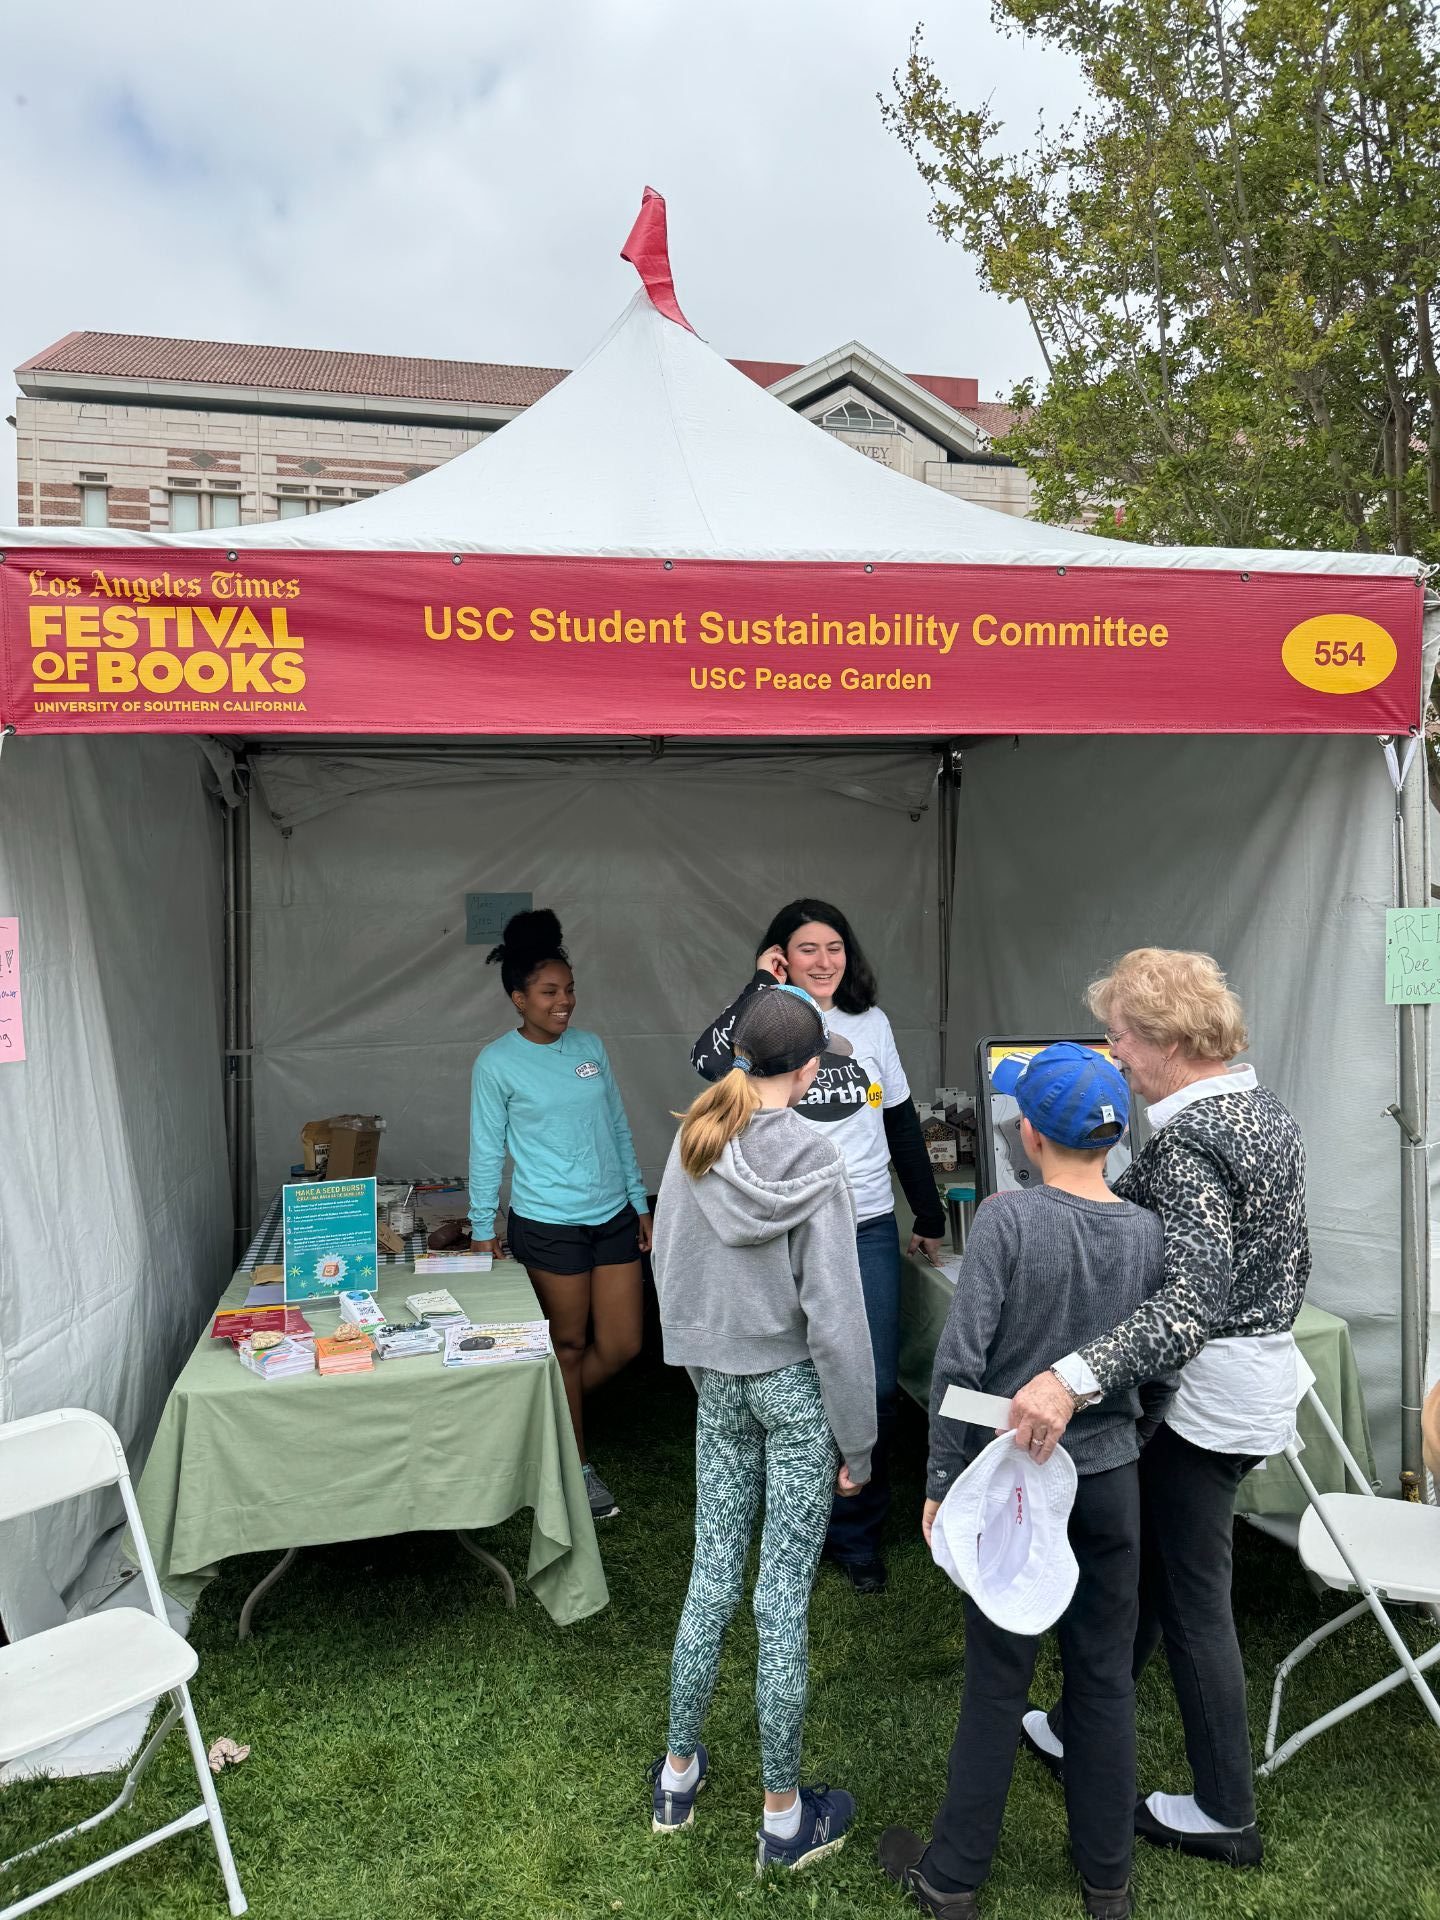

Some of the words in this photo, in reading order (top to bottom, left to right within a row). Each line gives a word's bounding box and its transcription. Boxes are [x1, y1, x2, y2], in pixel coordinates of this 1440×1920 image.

[29, 570, 81, 598] Los
[89, 570, 202, 603] Angeles
[211, 571, 301, 599] Times
[29, 605, 305, 649] FESTIVAL
[424, 606, 514, 641] USC
[529, 608, 685, 644] Student
[699, 611, 959, 654] Sustainability
[972, 613, 1168, 648] Committee
[1314, 640, 1366, 667] 554
[32, 651, 89, 681] OF
[96, 650, 306, 695] BOOKS
[690, 667, 745, 690] USC
[755, 667, 832, 690] Peace
[840, 668, 931, 690] Garden
[34, 701, 119, 713] UNIVERSITY
[122, 701, 141, 712] OF
[143, 700, 220, 713] SOUTHERN
[223, 700, 307, 713] CALIFORNIA
[1398, 946, 1432, 974] Bee
[814, 1062, 860, 1089] gmt
[797, 1081, 867, 1104] arth
